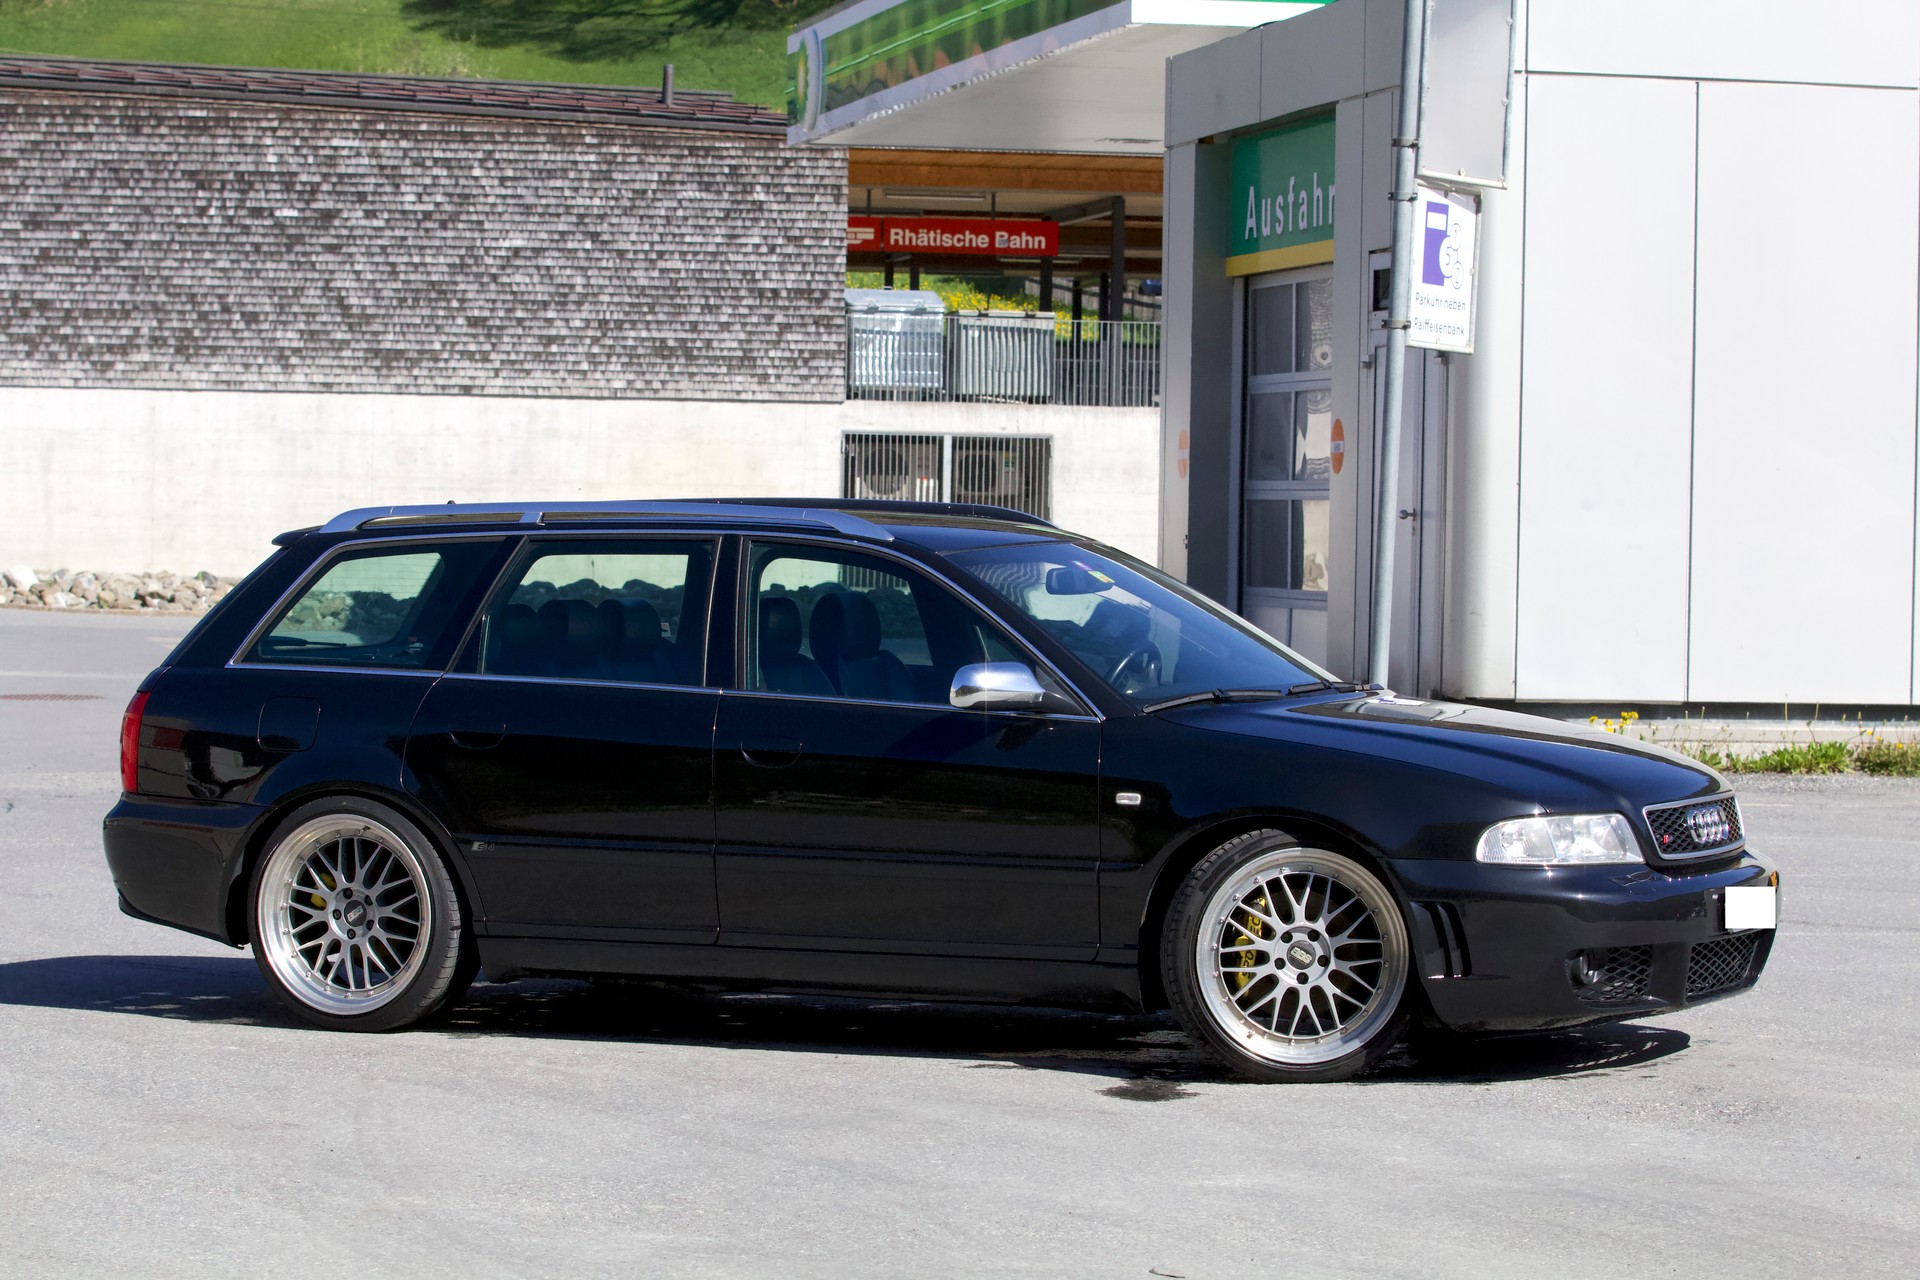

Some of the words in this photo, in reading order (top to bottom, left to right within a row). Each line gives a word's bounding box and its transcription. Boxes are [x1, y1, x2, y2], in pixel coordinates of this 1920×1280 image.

[889, 228, 990, 248] Rhätische
[995, 230, 1046, 250] Bahn
[1415, 292, 1443, 308] Parkuhr
[1444, 298, 1466, 312] neben
[1414, 317, 1465, 336] Raiffeisenbank
